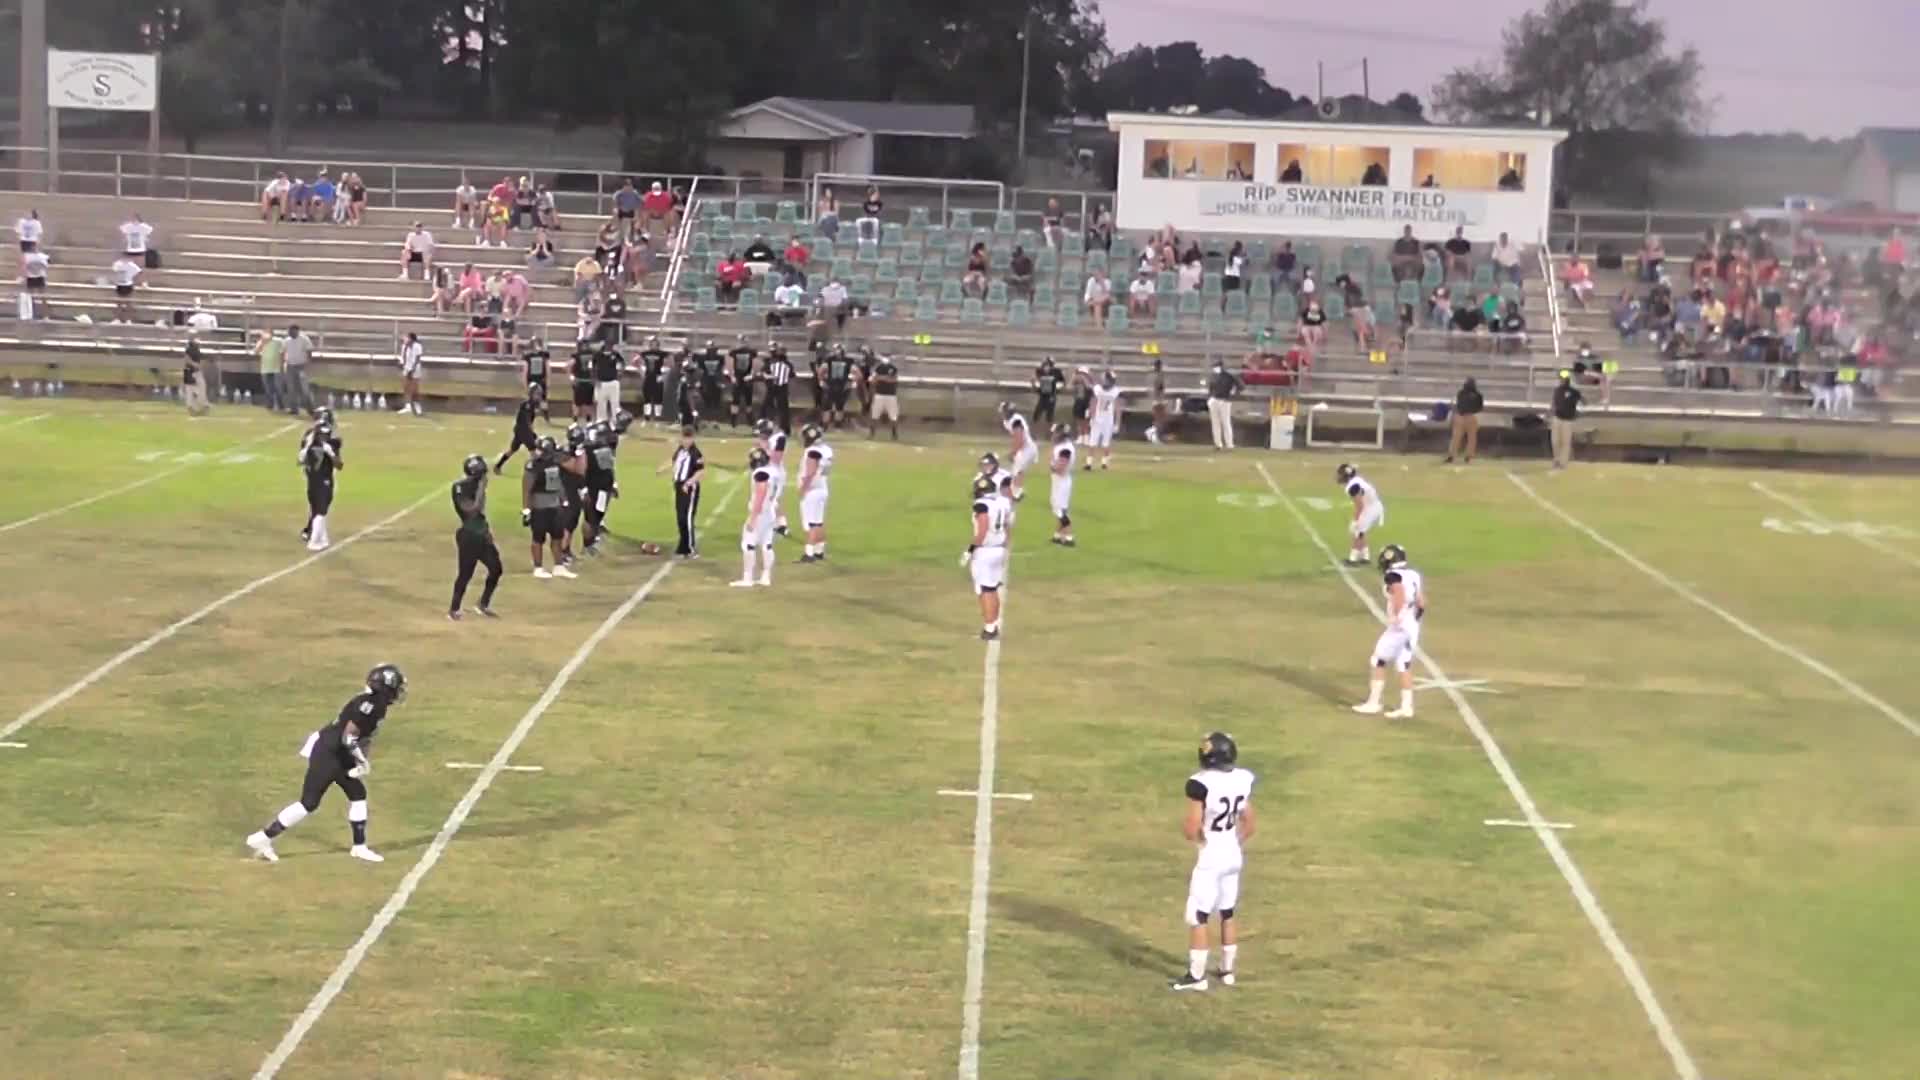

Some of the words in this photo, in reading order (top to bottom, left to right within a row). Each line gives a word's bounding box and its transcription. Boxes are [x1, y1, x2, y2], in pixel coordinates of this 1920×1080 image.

[1244, 185, 1277, 201] RIP
[1287, 187, 1384, 206] SWANNER
[1393, 190, 1446, 208] FIELD
[1216, 201, 1259, 215] HOME
[1266, 203, 1286, 216] OF
